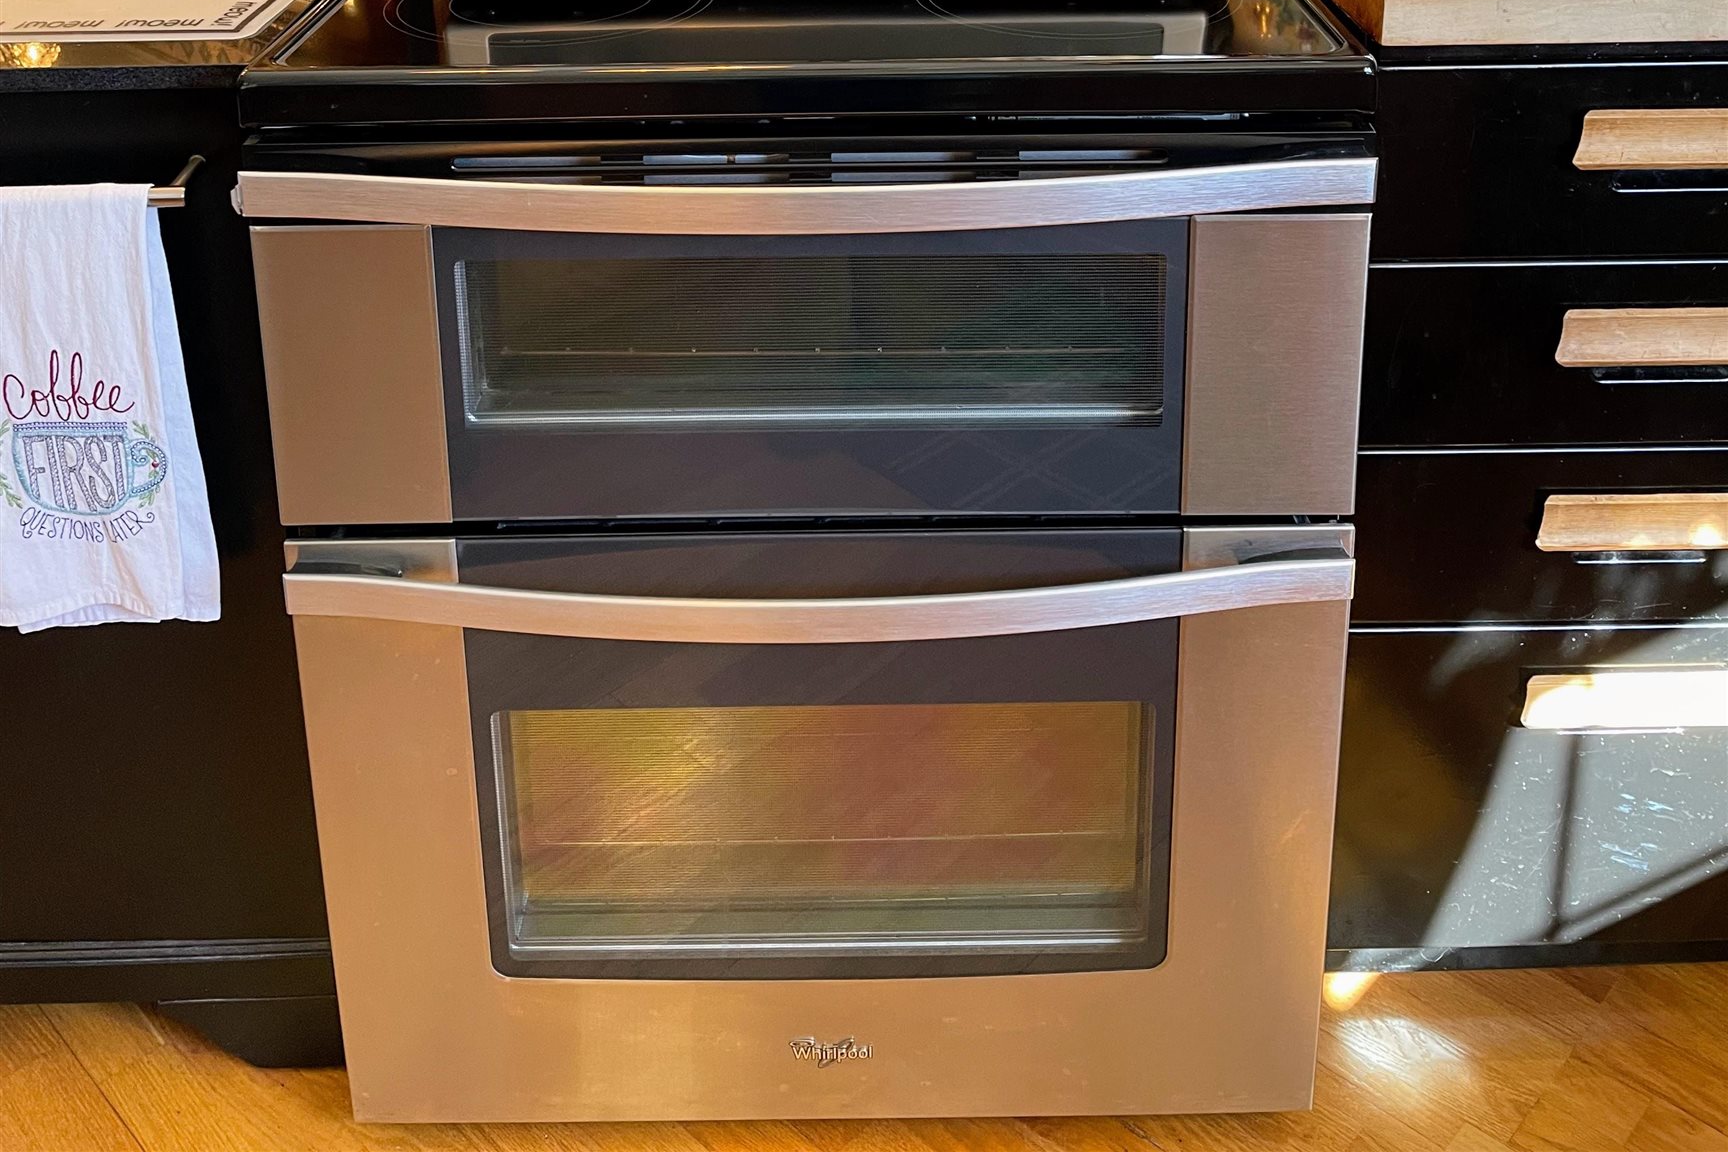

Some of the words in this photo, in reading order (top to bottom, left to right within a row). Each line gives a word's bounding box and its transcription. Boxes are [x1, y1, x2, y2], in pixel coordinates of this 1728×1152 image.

[14, 19, 105, 30] meow!
[115, 18, 205, 28] meow!
[210, 1, 257, 27] meow!
[3, 349, 136, 422] Coffee
[22, 434, 127, 513] FIRST
[19, 506, 105, 544] QUESTIONS
[104, 509, 156, 544] LATER
[792, 1044, 874, 1064] Whirlpool
